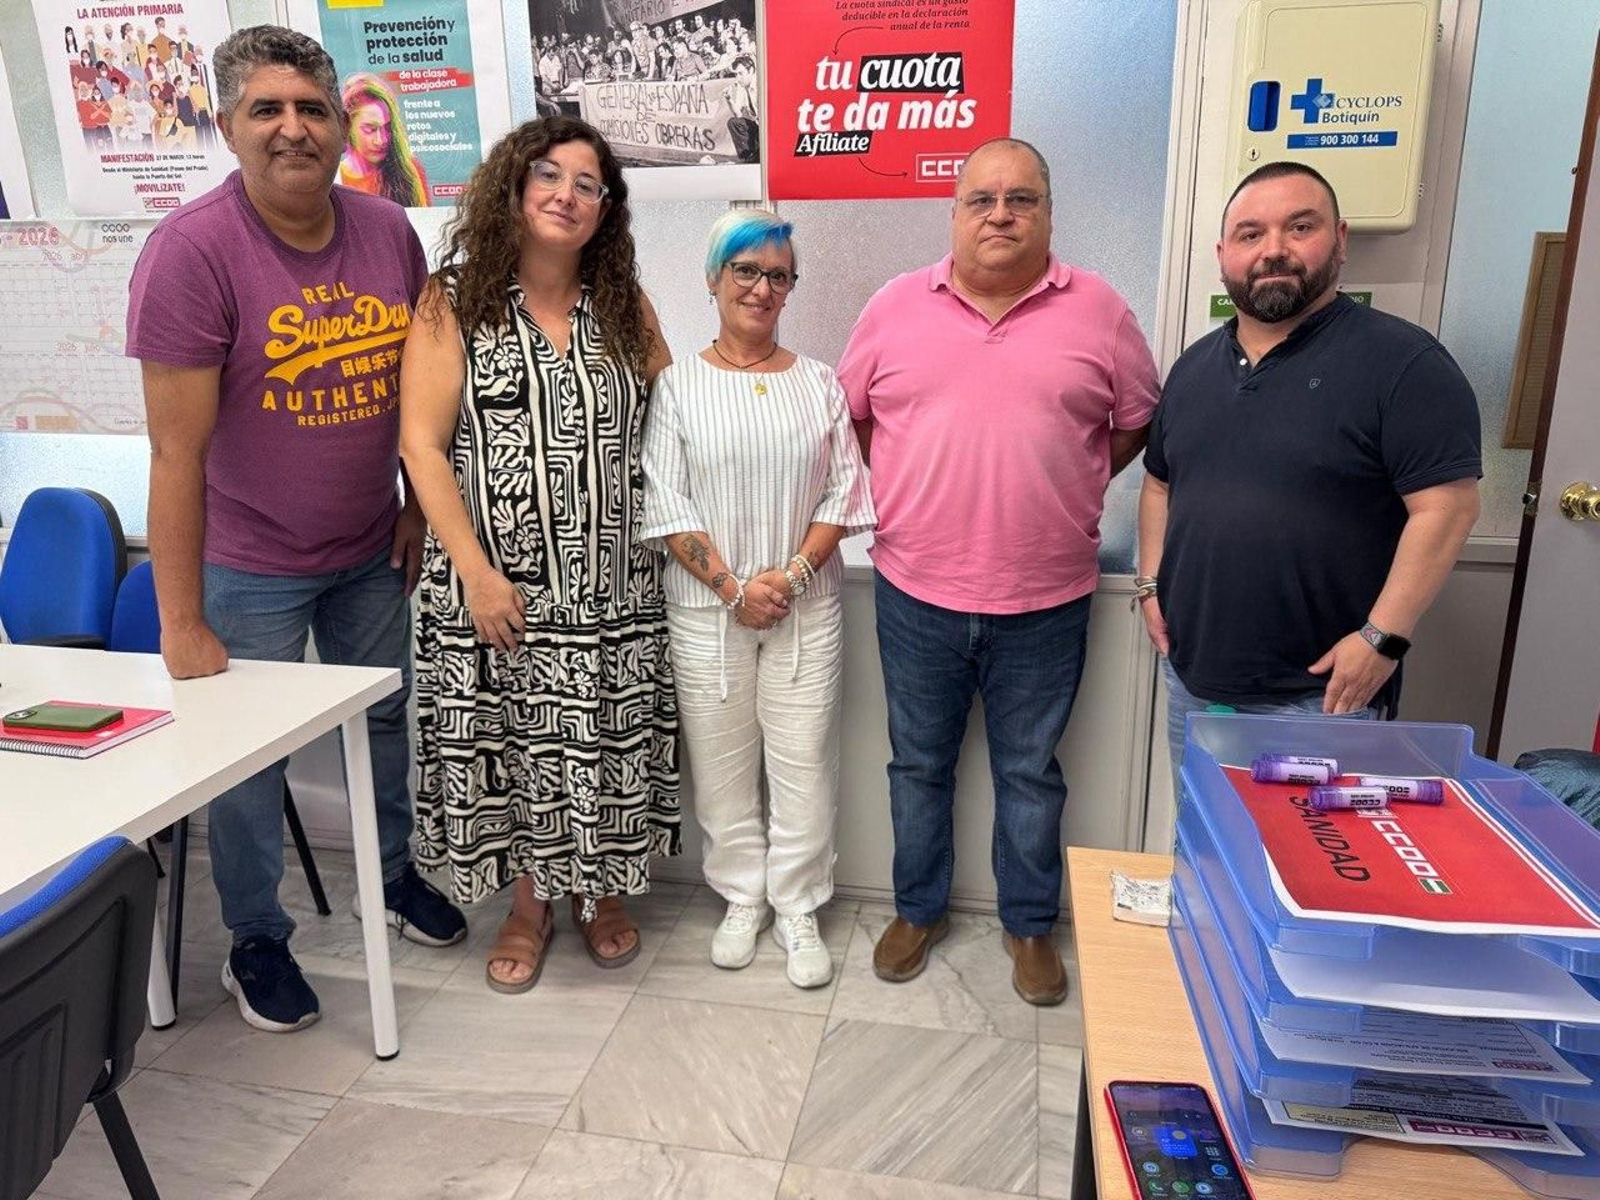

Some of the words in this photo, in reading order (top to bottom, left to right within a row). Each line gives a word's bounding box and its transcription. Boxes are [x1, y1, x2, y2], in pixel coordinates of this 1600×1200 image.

[76, 8, 89, 19] LA
[91, 4, 135, 19] ATENCIÓN
[138, 3, 184, 16] PRIMARIA
[842, 11, 887, 21] deducible
[901, 10, 911, 18] la
[912, 8, 968, 18] declaración
[364, 16, 446, 34] Prevención
[447, 20, 455, 32] y
[890, 21, 918, 31] anual
[919, 21, 930, 29] de
[932, 20, 942, 29] la
[944, 20, 970, 28] renta
[366, 32, 448, 53] protección
[368, 54, 384, 65] de
[388, 53, 400, 64] la
[402, 48, 444, 63] salud
[399, 69, 411, 79] de
[413, 69, 422, 78] la
[422, 69, 448, 78] clase
[815, 55, 853, 91] tu
[860, 51, 962, 90] cuota
[401, 79, 457, 93] trabajadora
[403, 99, 432, 109] frente
[1336, 96, 1402, 109] CYCLOPS
[405, 111, 419, 119] los
[420, 111, 456, 119] nuevos
[797, 97, 835, 132] te
[843, 92, 890, 131] da
[897, 89, 978, 130] más
[1322, 110, 1380, 125] Botiquín
[406, 121, 431, 131] retos
[408, 132, 449, 145] digitales
[449, 133, 457, 142] y
[655, 123, 715, 151] OBRERAS
[1320, 135, 1338, 145] 900
[1340, 134, 1359, 144] 300
[1361, 134, 1379, 143] 144
[409, 142, 473, 152] psicosociales
[100, 152, 155, 163] MANIFESTACIÓN
[433, 186, 463, 196] CCOO
[154, 199, 179, 207] CCOO
[19, 226, 60, 246] 2026
[102, 235, 117, 243] nos
[118, 234, 133, 243] une
[302, 282, 355, 305] REAL
[262, 372, 399, 411] AUTHENT
[1288, 796, 1371, 882] SANIDAD
[1372, 818, 1438, 880] CCOO
